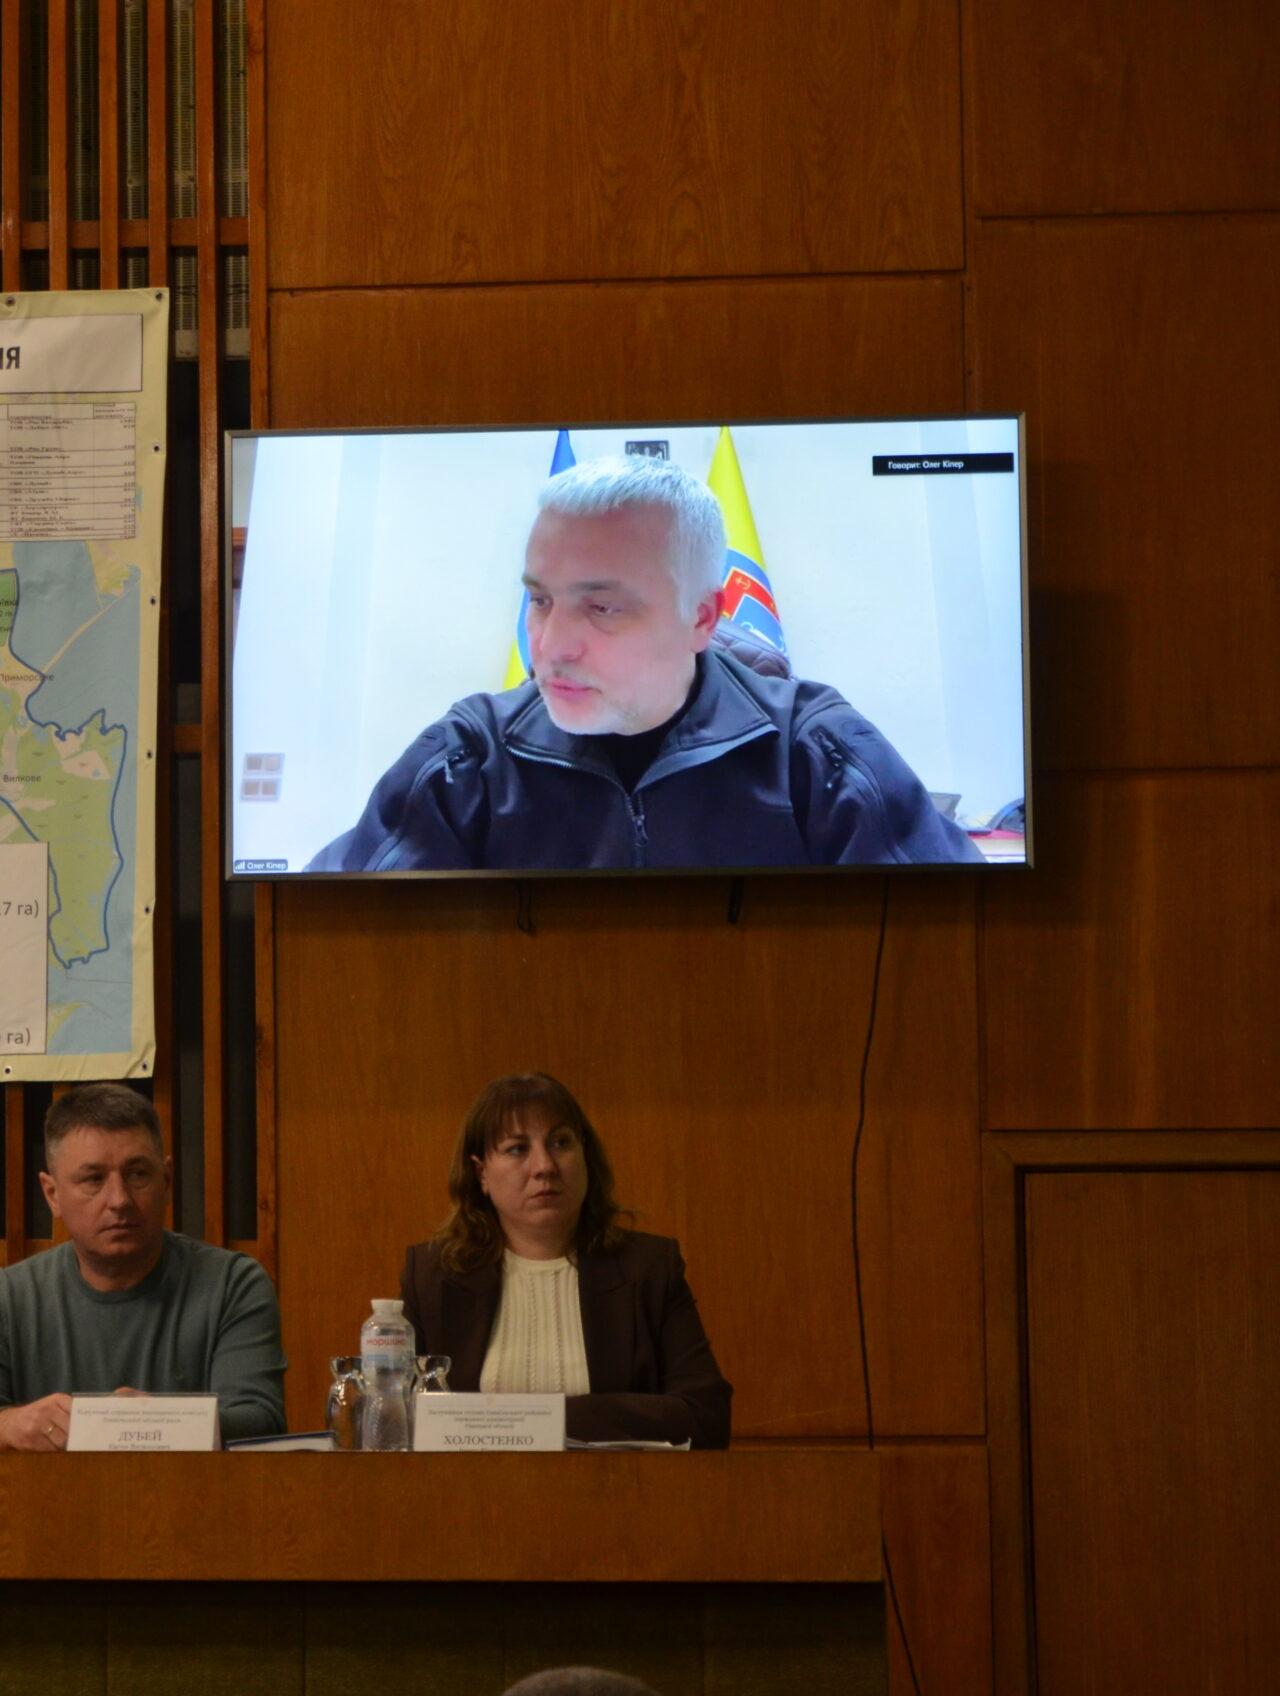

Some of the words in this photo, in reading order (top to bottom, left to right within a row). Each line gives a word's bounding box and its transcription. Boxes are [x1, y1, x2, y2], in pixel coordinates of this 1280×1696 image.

[888, 460, 921, 471] Говорит:
[922, 460, 941, 470] Олег
[942, 460, 964, 470] Кіпер
[2, 774, 43, 784] Вилкове
[17, 900, 40, 919] га)
[6, 1028, 32, 1047] га)
[118, 1430, 163, 1442] ДУБЕЙ
[443, 1434, 535, 1446] ХОЛОСТЕНКО
